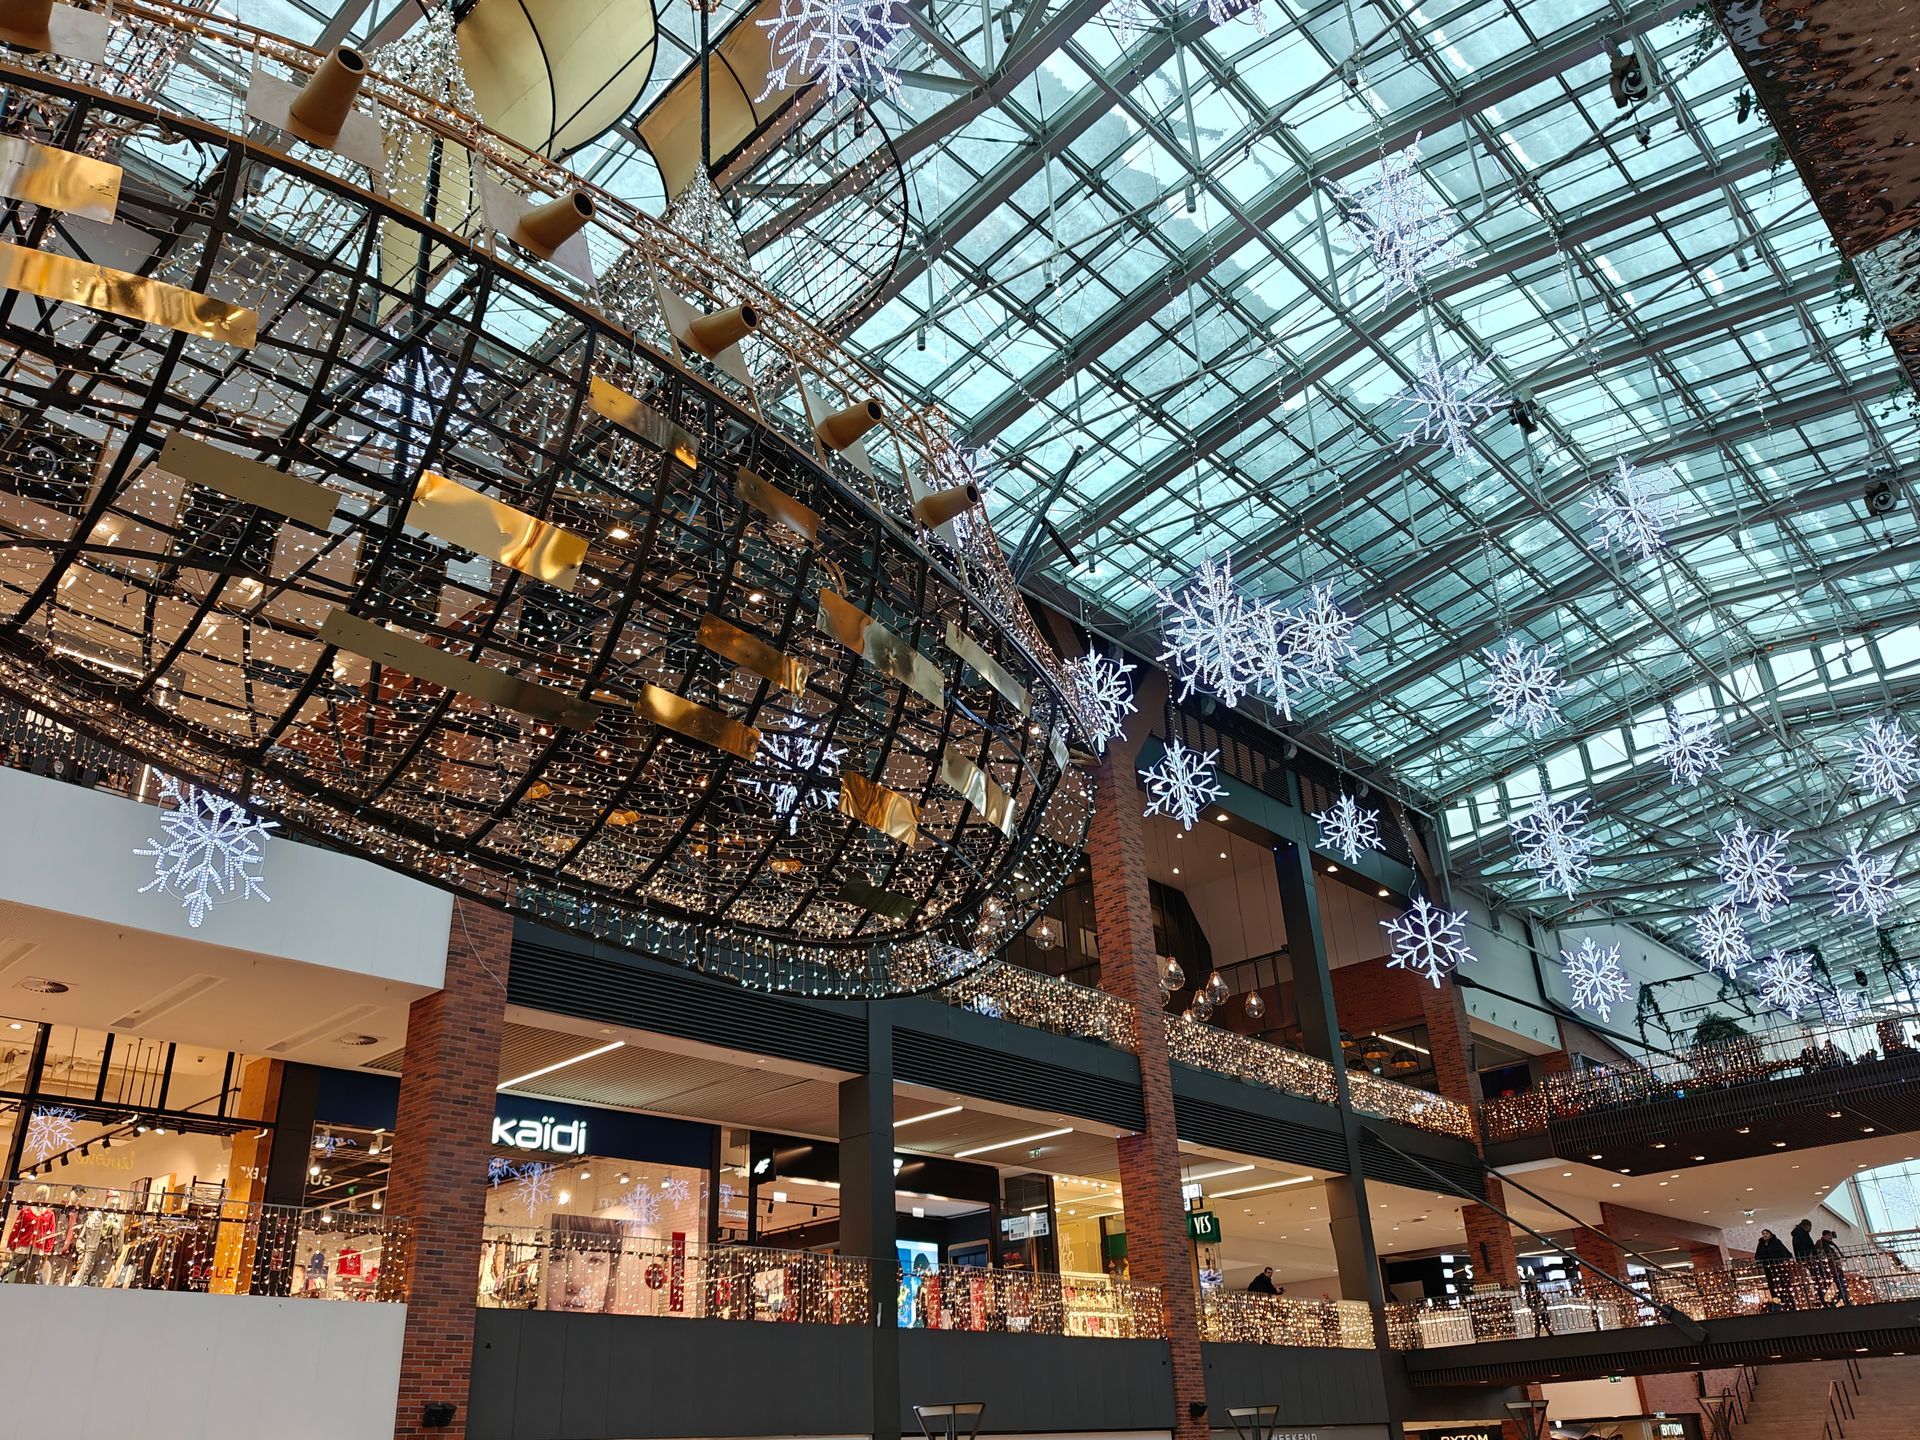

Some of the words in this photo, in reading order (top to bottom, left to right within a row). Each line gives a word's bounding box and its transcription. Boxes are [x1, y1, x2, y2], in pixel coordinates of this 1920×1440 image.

[492, 1115, 587, 1155] kaïdi
[1193, 1215, 1212, 1235] YES
[192, 1265, 235, 1279] SALE
[1660, 1423, 1684, 1436] BYTOM
